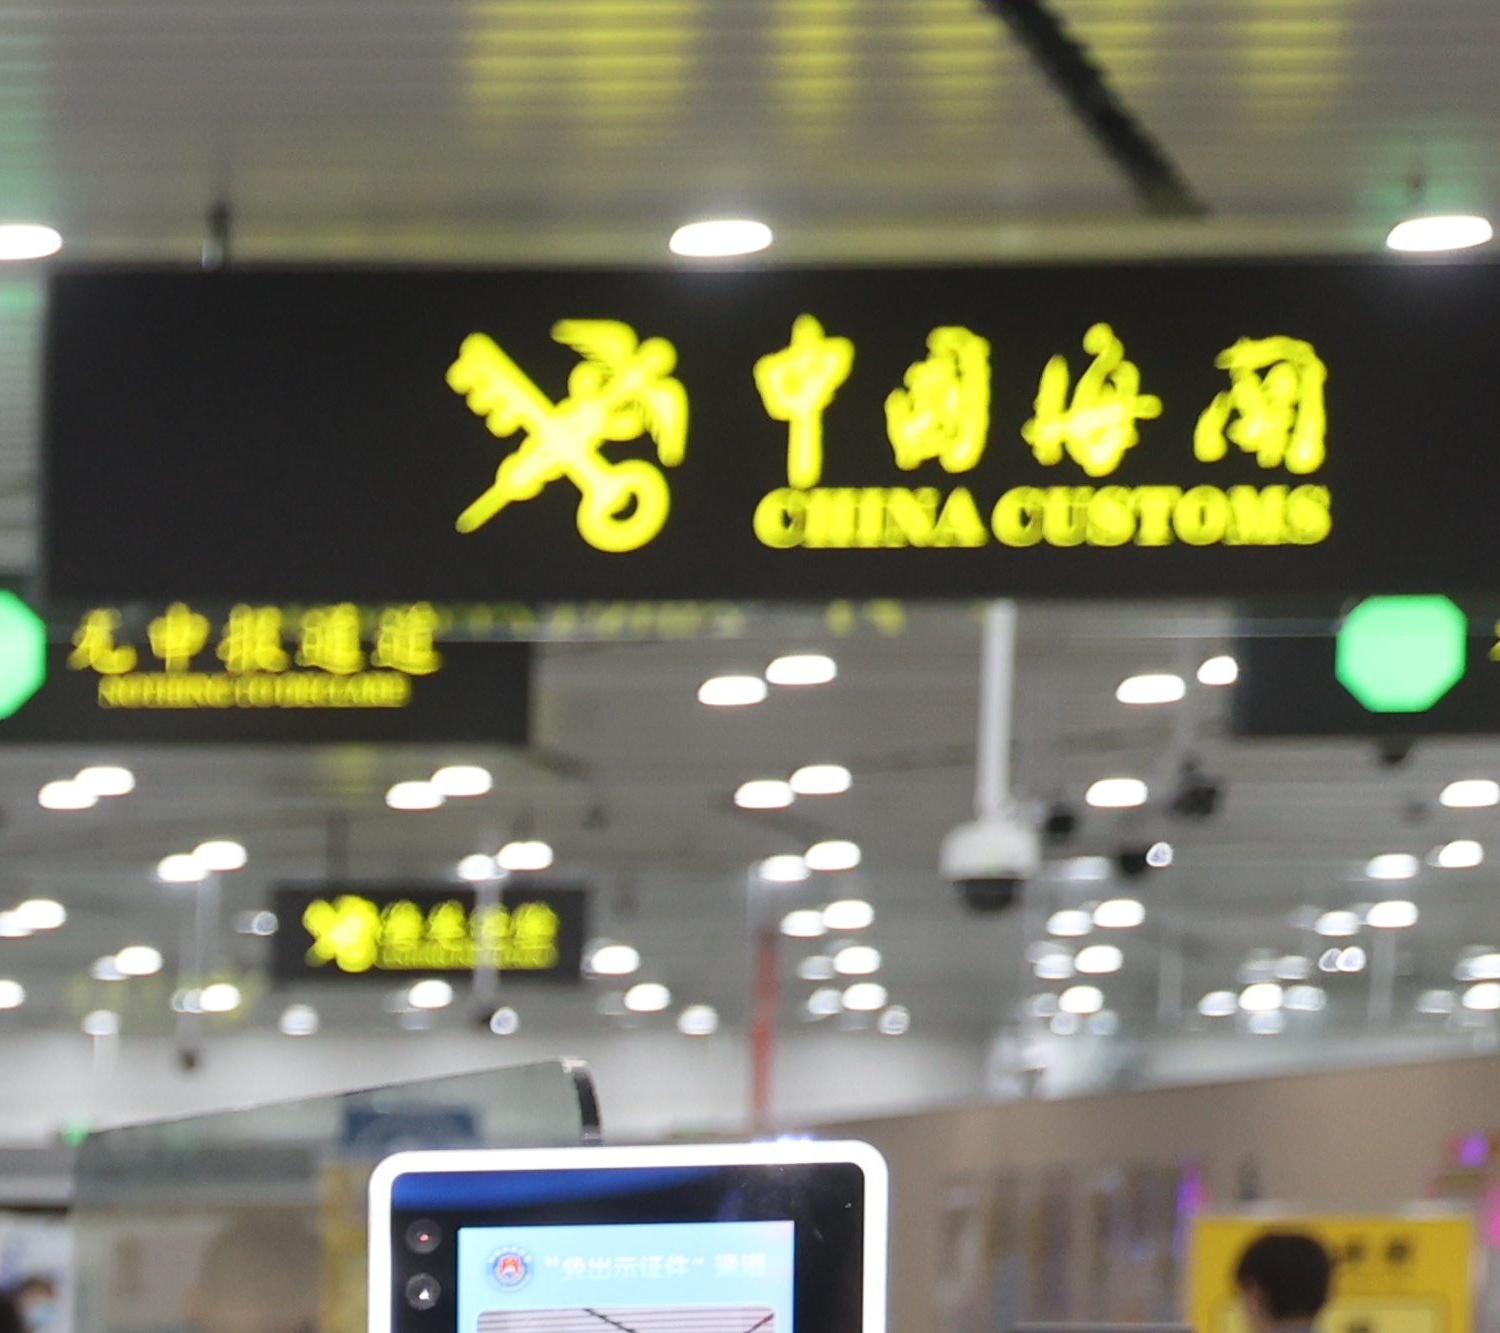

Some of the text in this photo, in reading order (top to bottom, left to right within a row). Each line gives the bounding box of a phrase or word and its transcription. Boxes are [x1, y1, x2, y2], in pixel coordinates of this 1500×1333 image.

[753, 313, 1327, 489] 中国海关
[753, 485, 1332, 548] CHINA CUSTOMS
[68, 601, 443, 675] 无申报通道
